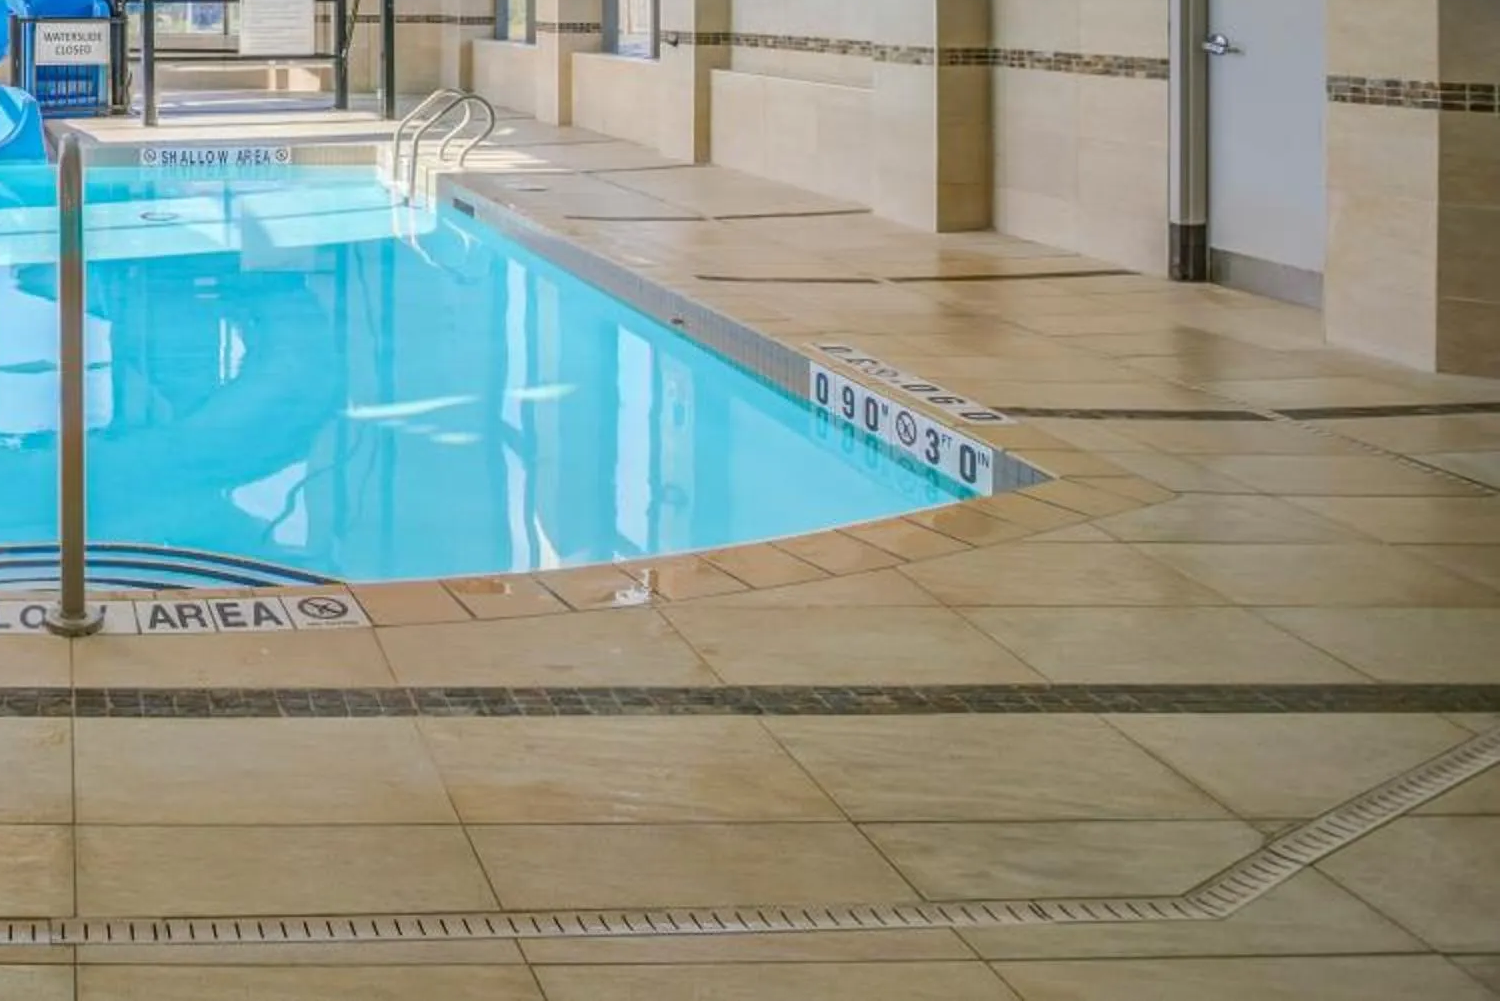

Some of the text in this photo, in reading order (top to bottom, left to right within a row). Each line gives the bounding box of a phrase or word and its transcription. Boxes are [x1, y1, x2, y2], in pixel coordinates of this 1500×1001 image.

[55, 44, 92, 55] CLOSED
[161, 149, 271, 165] SHALLOW AREA
[148, 601, 283, 629] AREA
